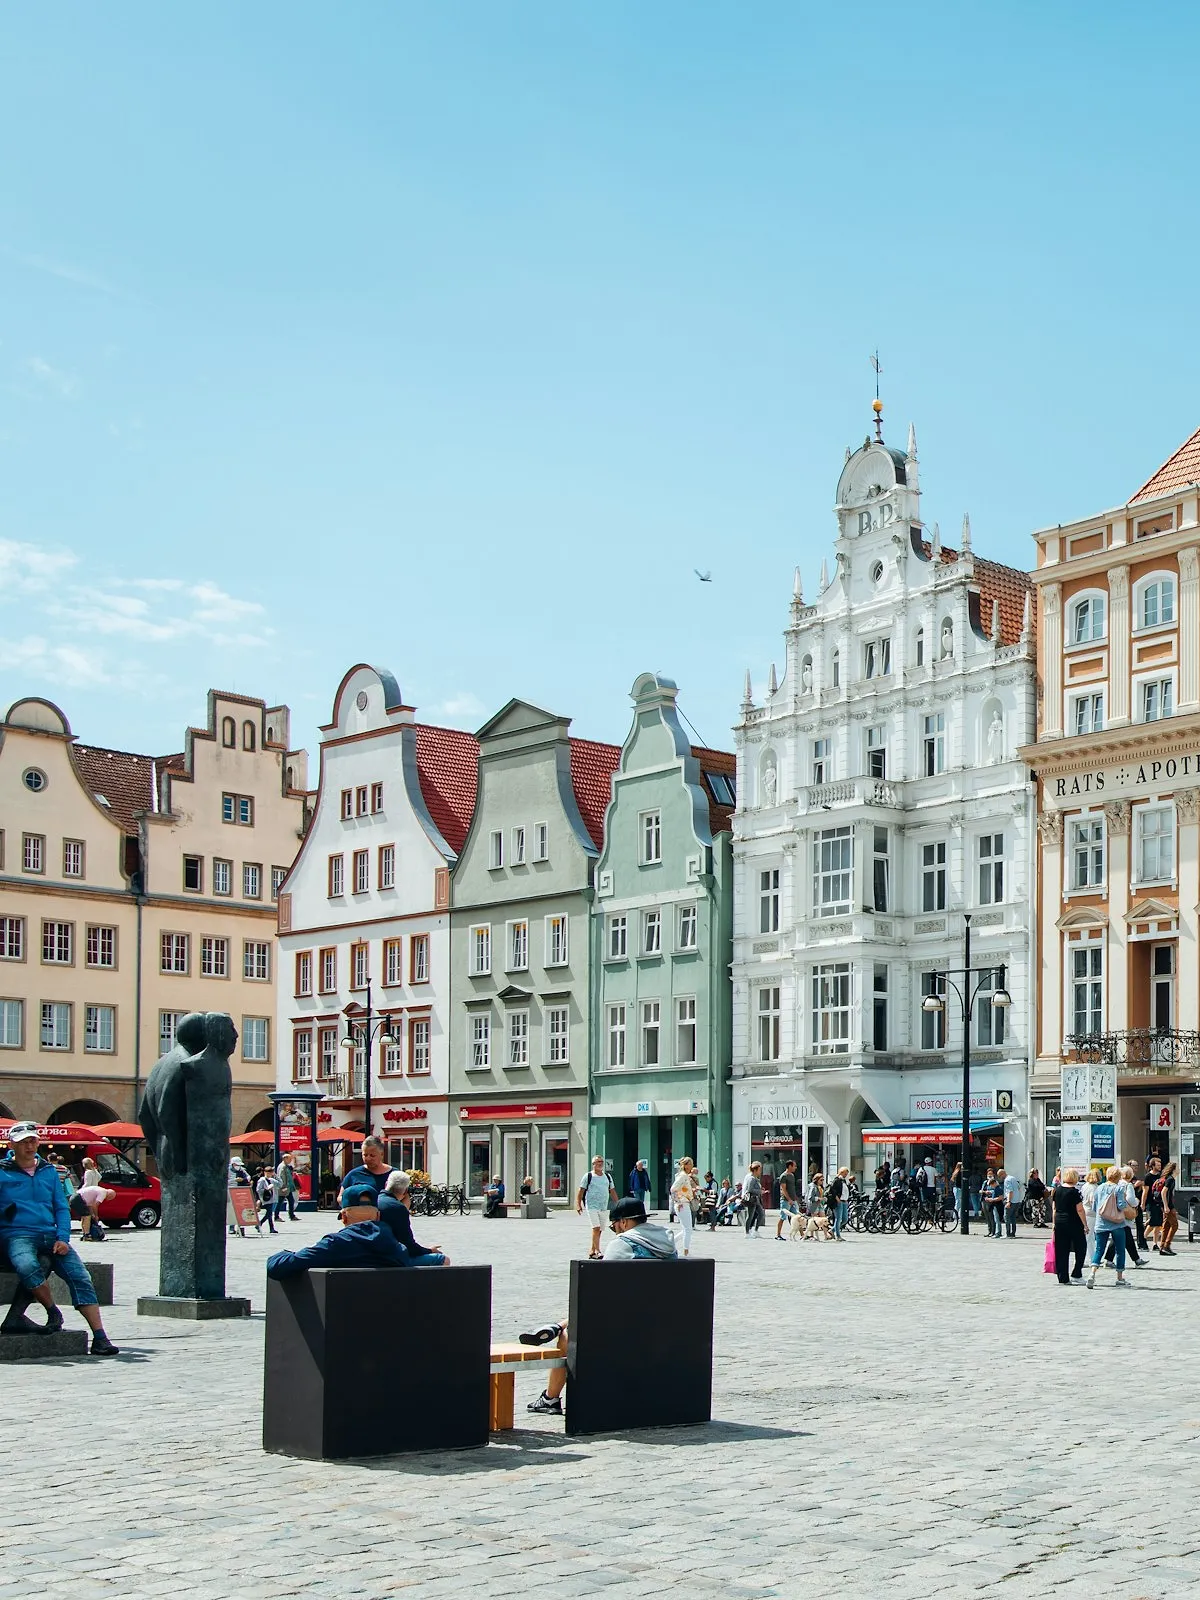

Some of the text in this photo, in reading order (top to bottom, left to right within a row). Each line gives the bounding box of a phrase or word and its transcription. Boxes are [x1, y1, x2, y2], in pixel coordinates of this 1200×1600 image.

[1055, 771, 1106, 797] RATS
[638, 1103, 649, 1112] DKB
[916, 1100, 953, 1110] ROSTOCK
[752, 1105, 816, 1121] FESTMODE
